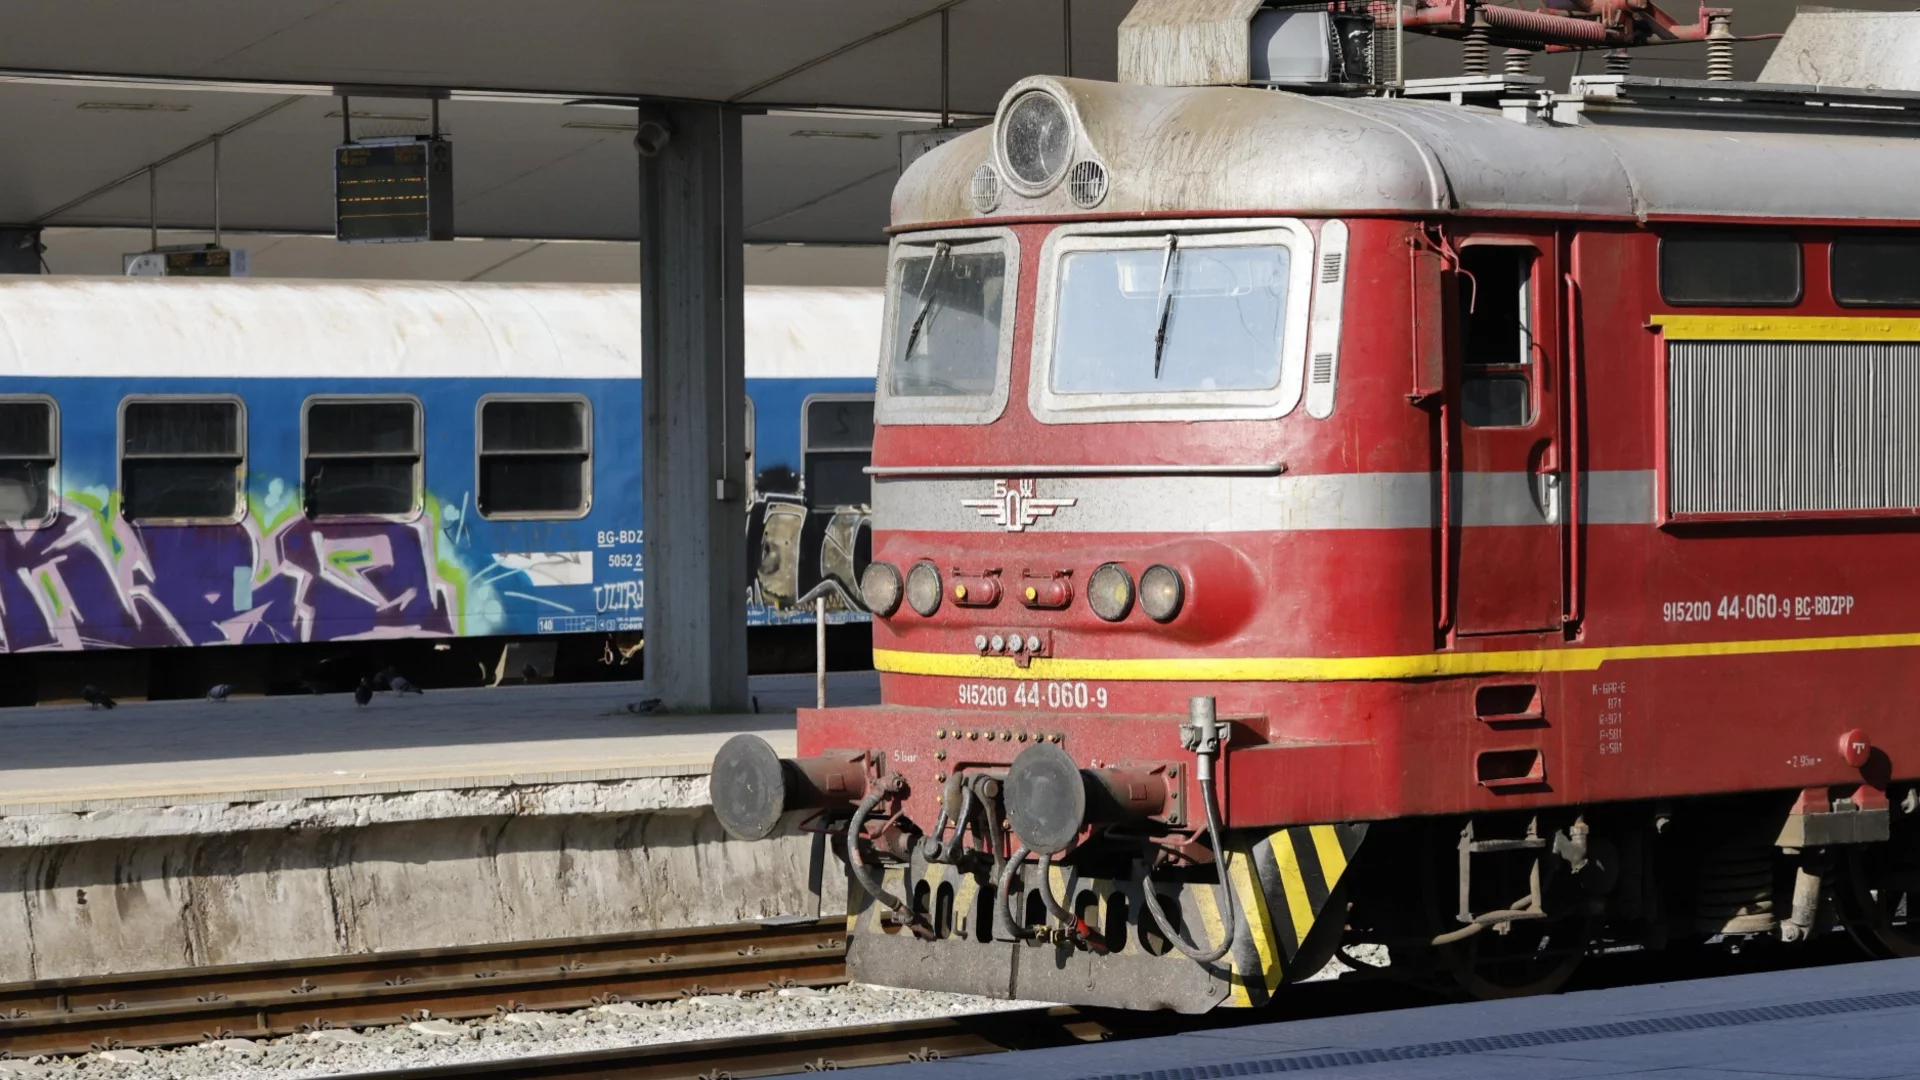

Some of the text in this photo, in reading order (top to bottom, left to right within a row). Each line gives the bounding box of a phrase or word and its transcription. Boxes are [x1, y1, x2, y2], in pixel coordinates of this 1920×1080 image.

[608, 554, 633, 567] 5052
[1663, 601, 1711, 622] 915200
[540, 620, 553, 632] 140
[958, 683, 1007, 707] 915200
[901, 751, 917, 762] bar
